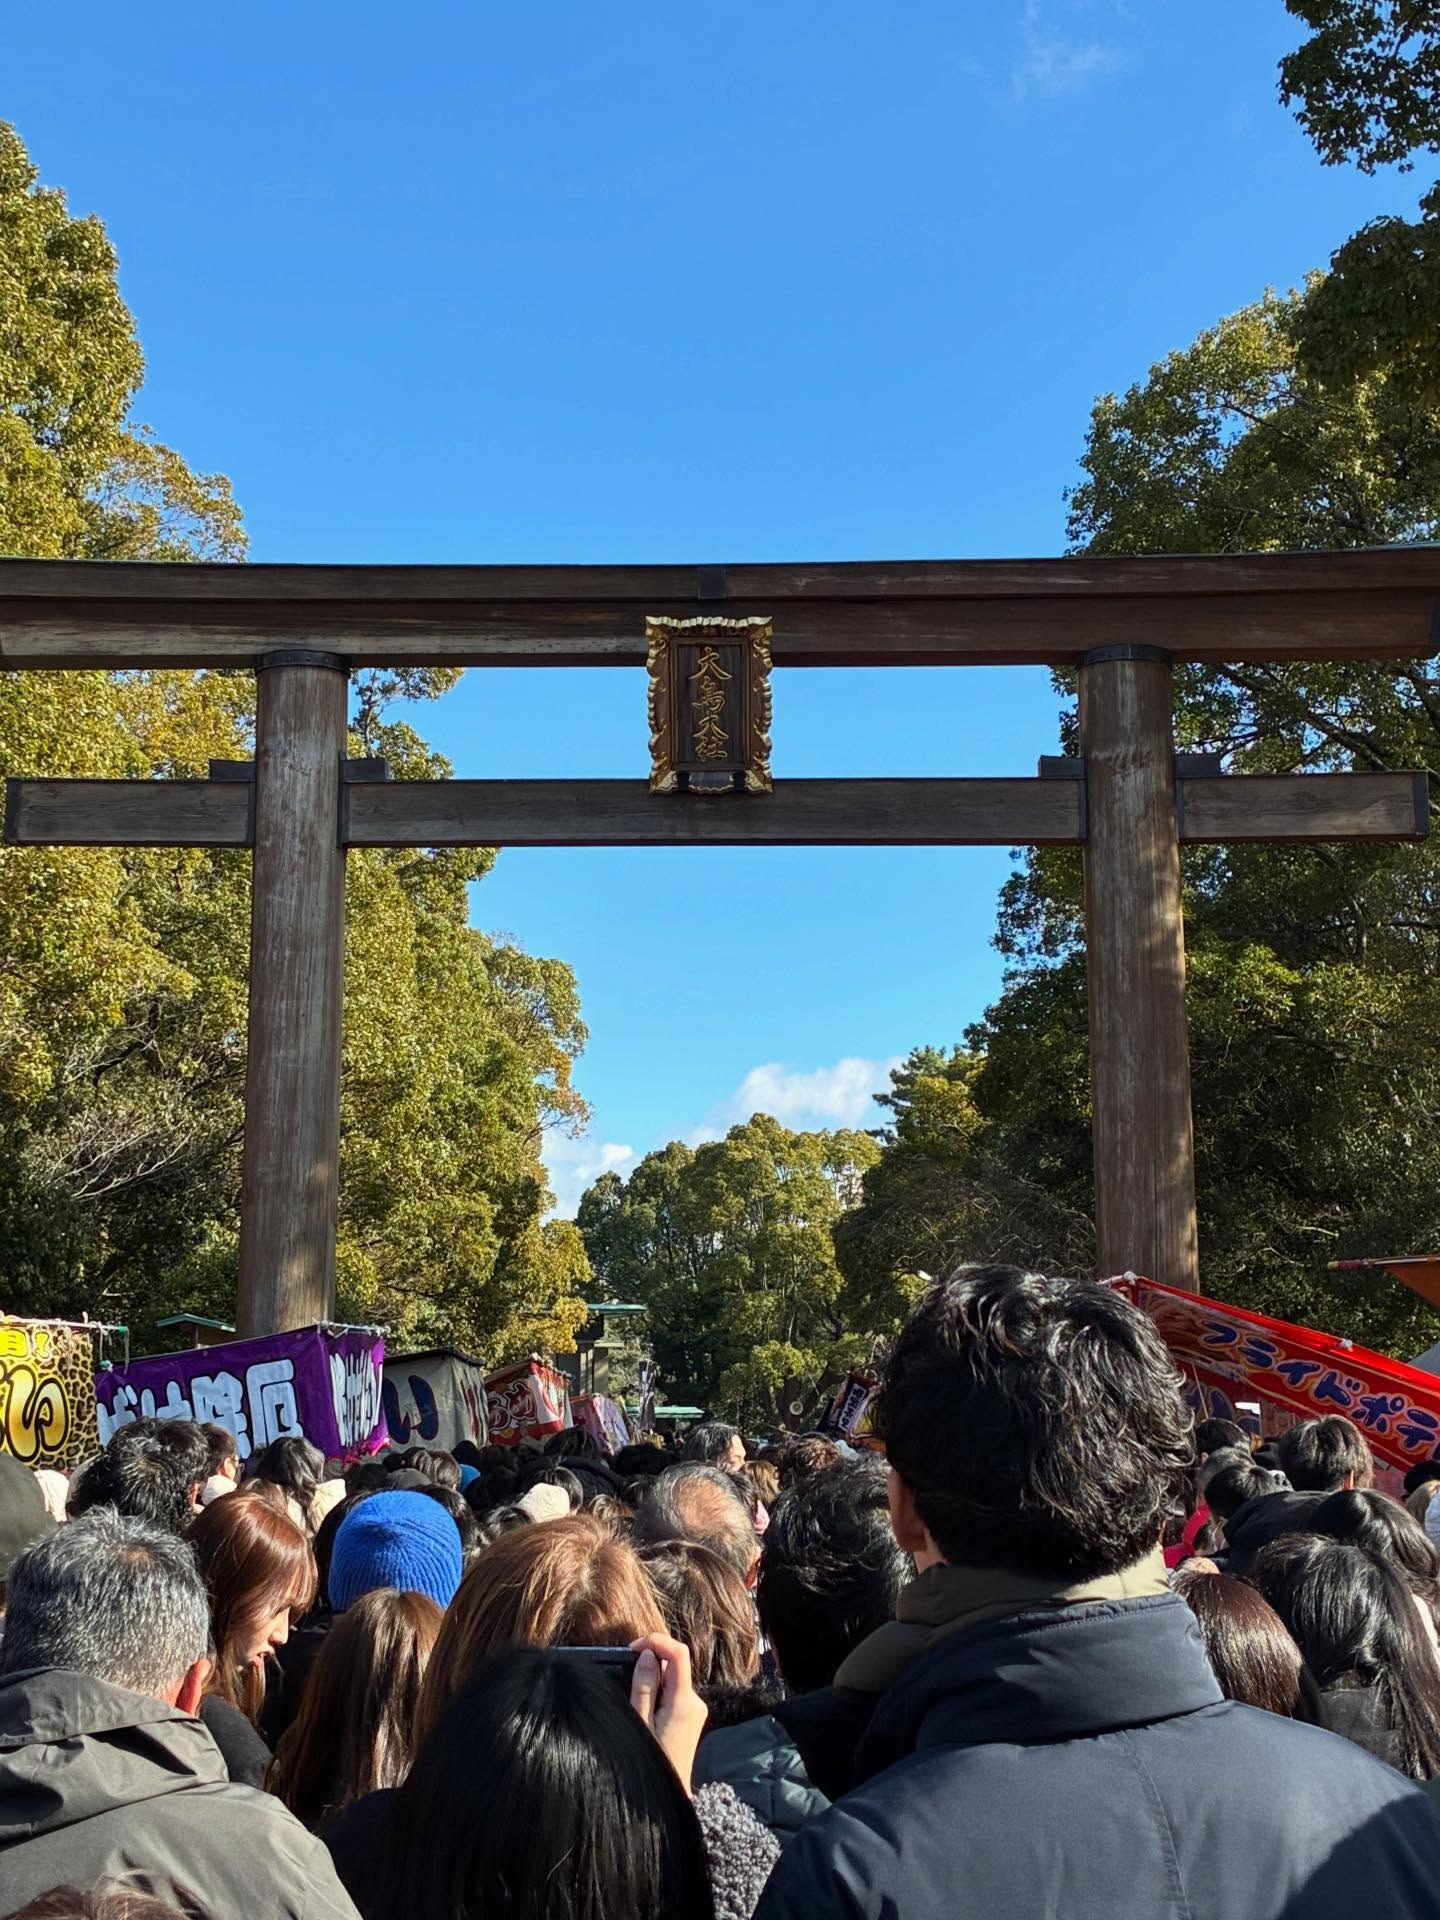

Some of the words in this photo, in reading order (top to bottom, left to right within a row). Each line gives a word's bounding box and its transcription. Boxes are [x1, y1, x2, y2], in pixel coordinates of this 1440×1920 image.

[1201, 1320, 1440, 1460] フライドポテ
